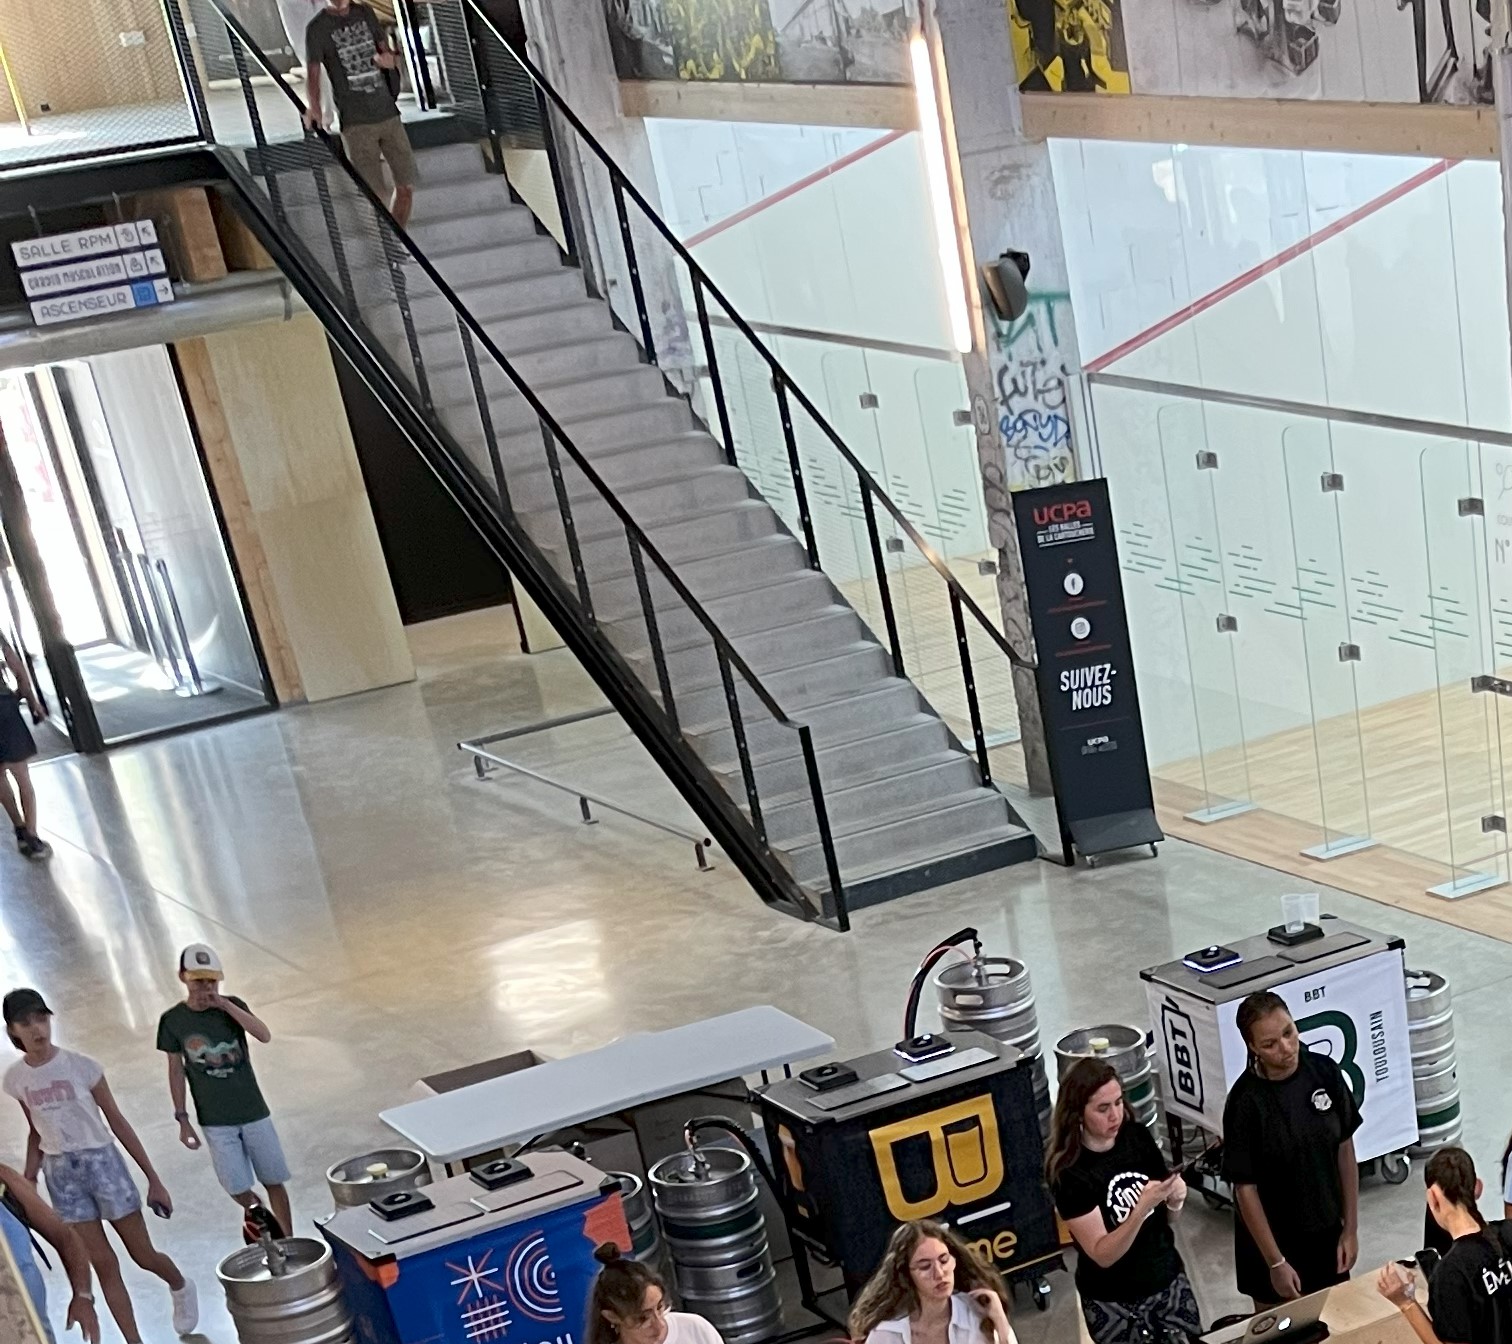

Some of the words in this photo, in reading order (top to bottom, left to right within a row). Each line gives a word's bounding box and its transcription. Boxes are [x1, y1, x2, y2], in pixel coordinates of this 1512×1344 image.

[20, 240, 70, 261] SALLE
[78, 233, 112, 250] RPM
[40, 291, 127, 319] ASCENSEUR
[1060, 663, 1118, 692] SUIVEZ-
[1072, 685, 1112, 711] NOUS
[1304, 986, 1326, 1003] BBT
[1168, 1018, 1196, 1097] BBT
[1370, 1010, 1390, 1083] TOULOUSAIN
